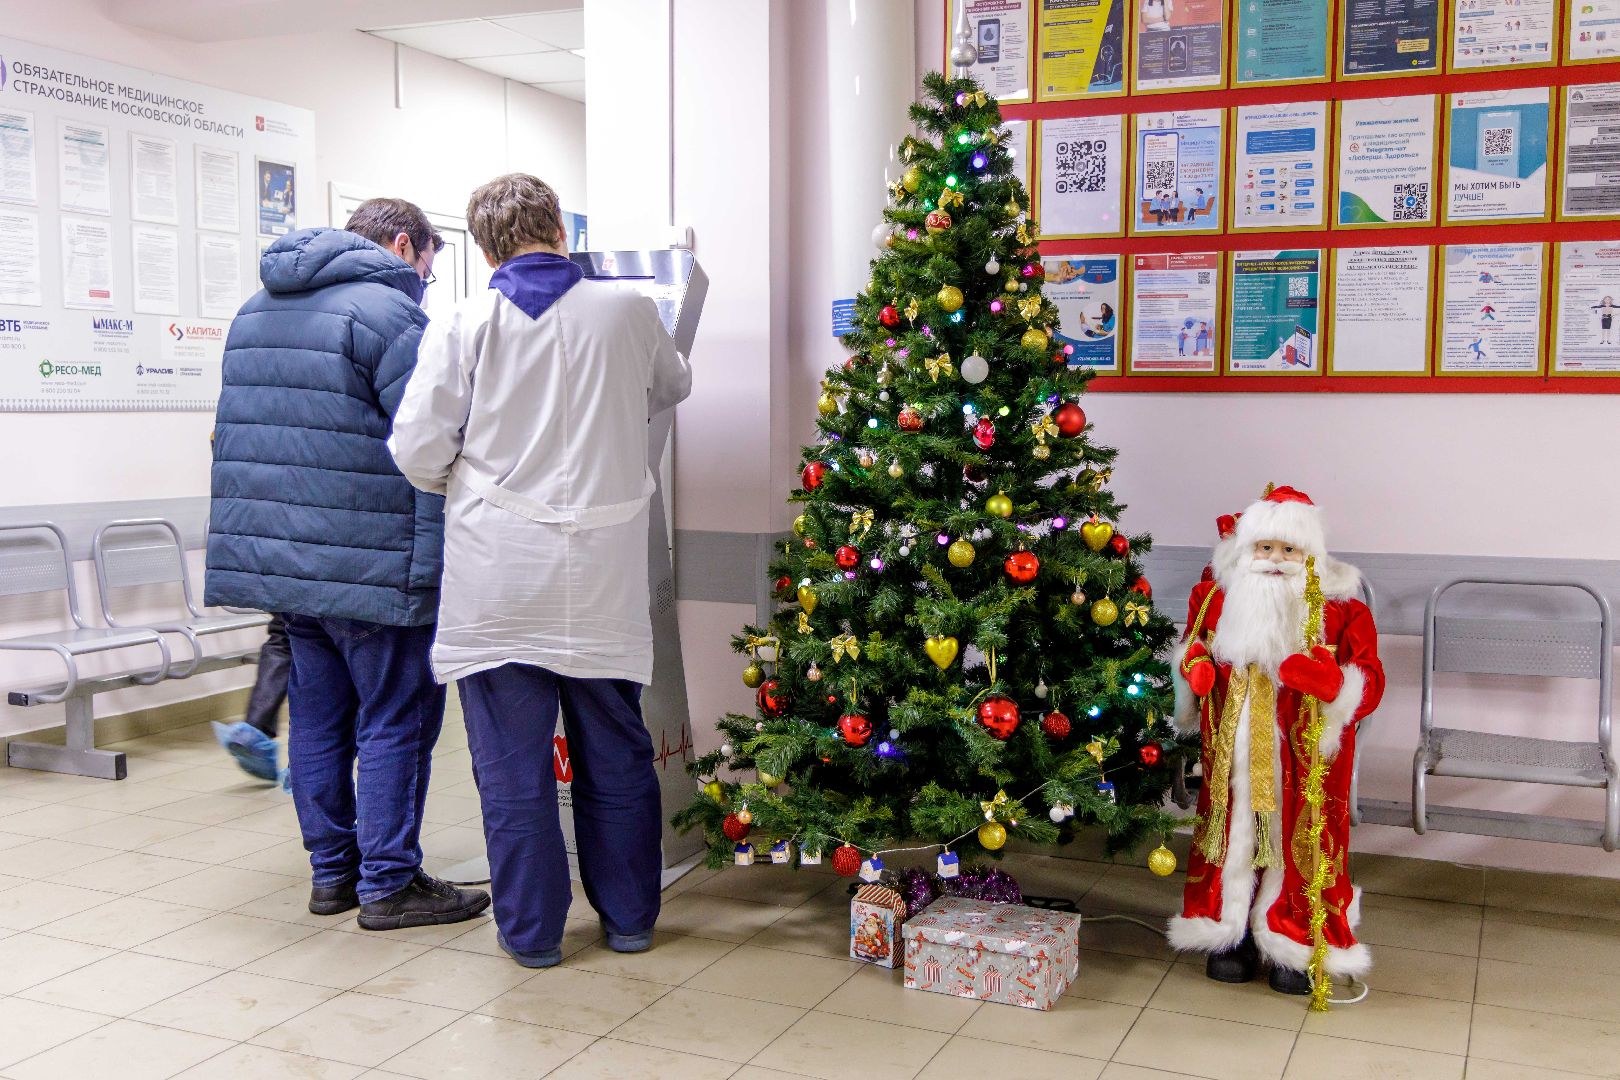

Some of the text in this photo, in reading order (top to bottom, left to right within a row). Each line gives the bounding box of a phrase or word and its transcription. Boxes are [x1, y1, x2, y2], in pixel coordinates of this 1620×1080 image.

[12, 61, 205, 115] ОБЯЗАТЕЛЬНОЕ МЕДИЦИНСКОЕ
[13, 79, 109, 110] СТРАХОВАНИЕ
[111, 102, 191, 128] МОСКОВСКОЙ
[193, 118, 245, 138] ОБЛАСТИ
[1454, 181, 1521, 191] МЫ ХОТИМ БЫТЬ
[1454, 192, 1484, 202] ЛУЧШЕ!
[0, 319, 22, 332] ВТБ
[100, 318, 133, 331] МАКС-М
[186, 326, 222, 336] КАПИТАЛ
[55, 365, 102, 377] РЕСО-МЕД
